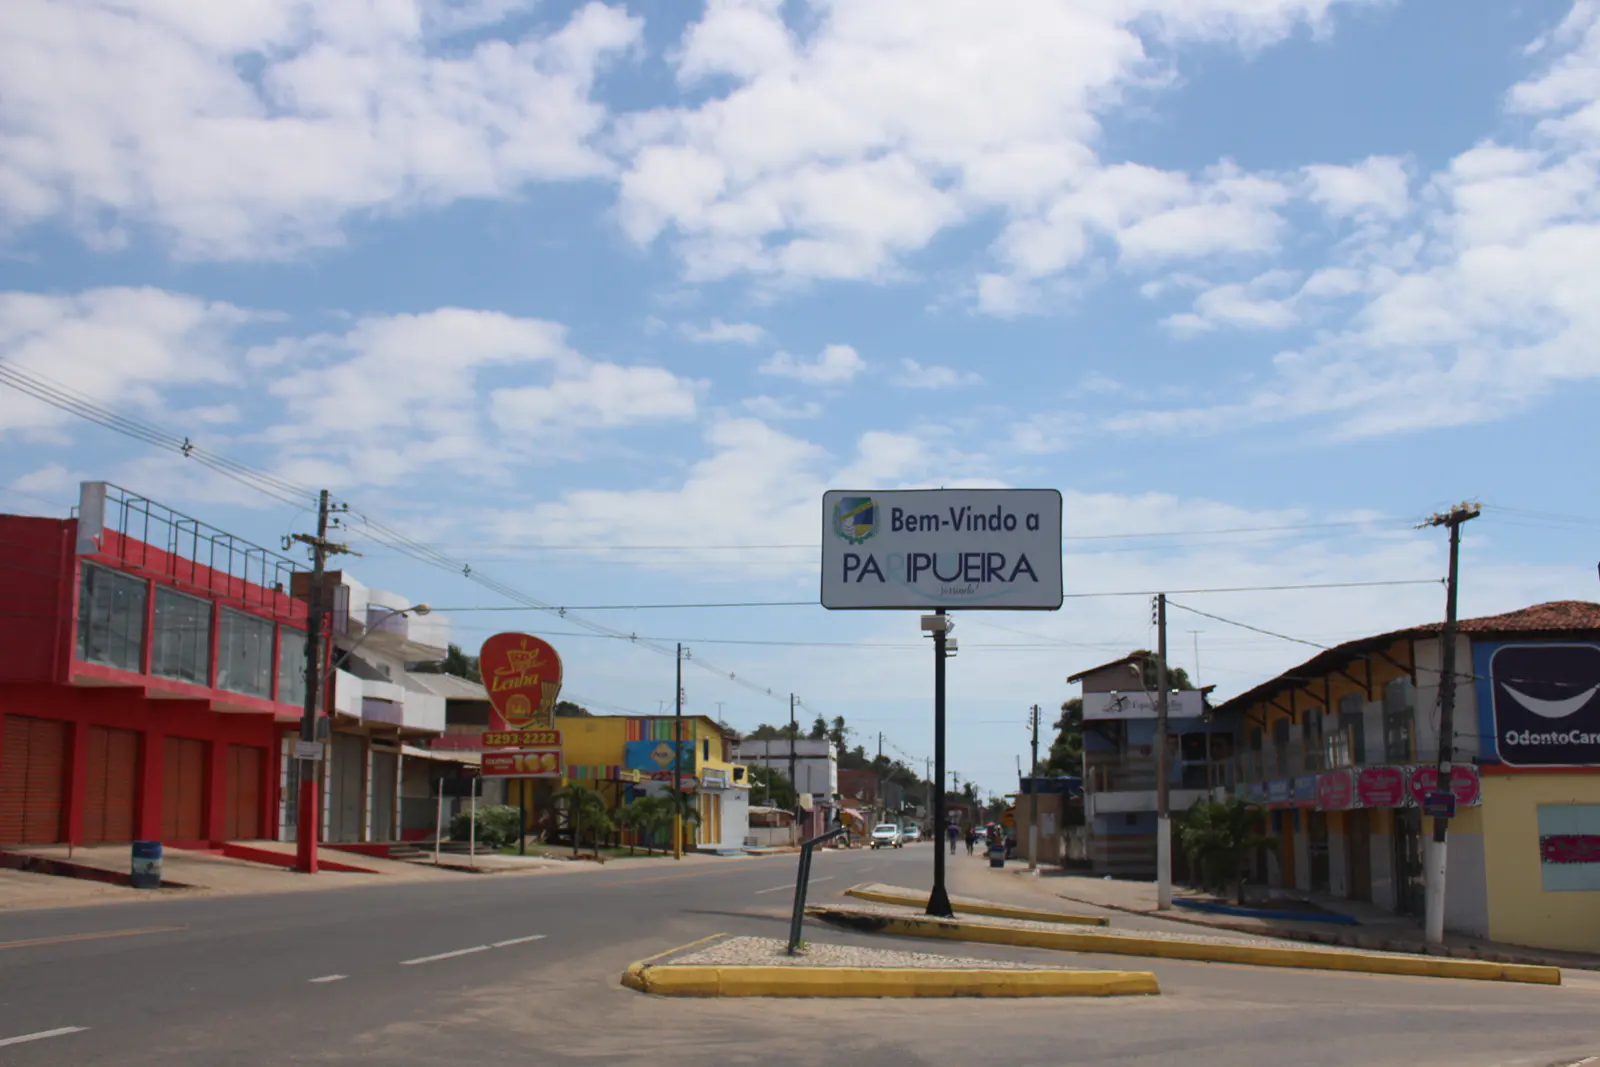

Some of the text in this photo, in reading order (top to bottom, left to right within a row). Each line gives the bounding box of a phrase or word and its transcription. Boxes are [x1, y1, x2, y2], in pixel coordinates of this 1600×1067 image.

[891, 505, 1039, 532] Bem-Vindo a
[842, 552, 1039, 583] PARIPUEIRA
[492, 671, 539, 692] Lenha
